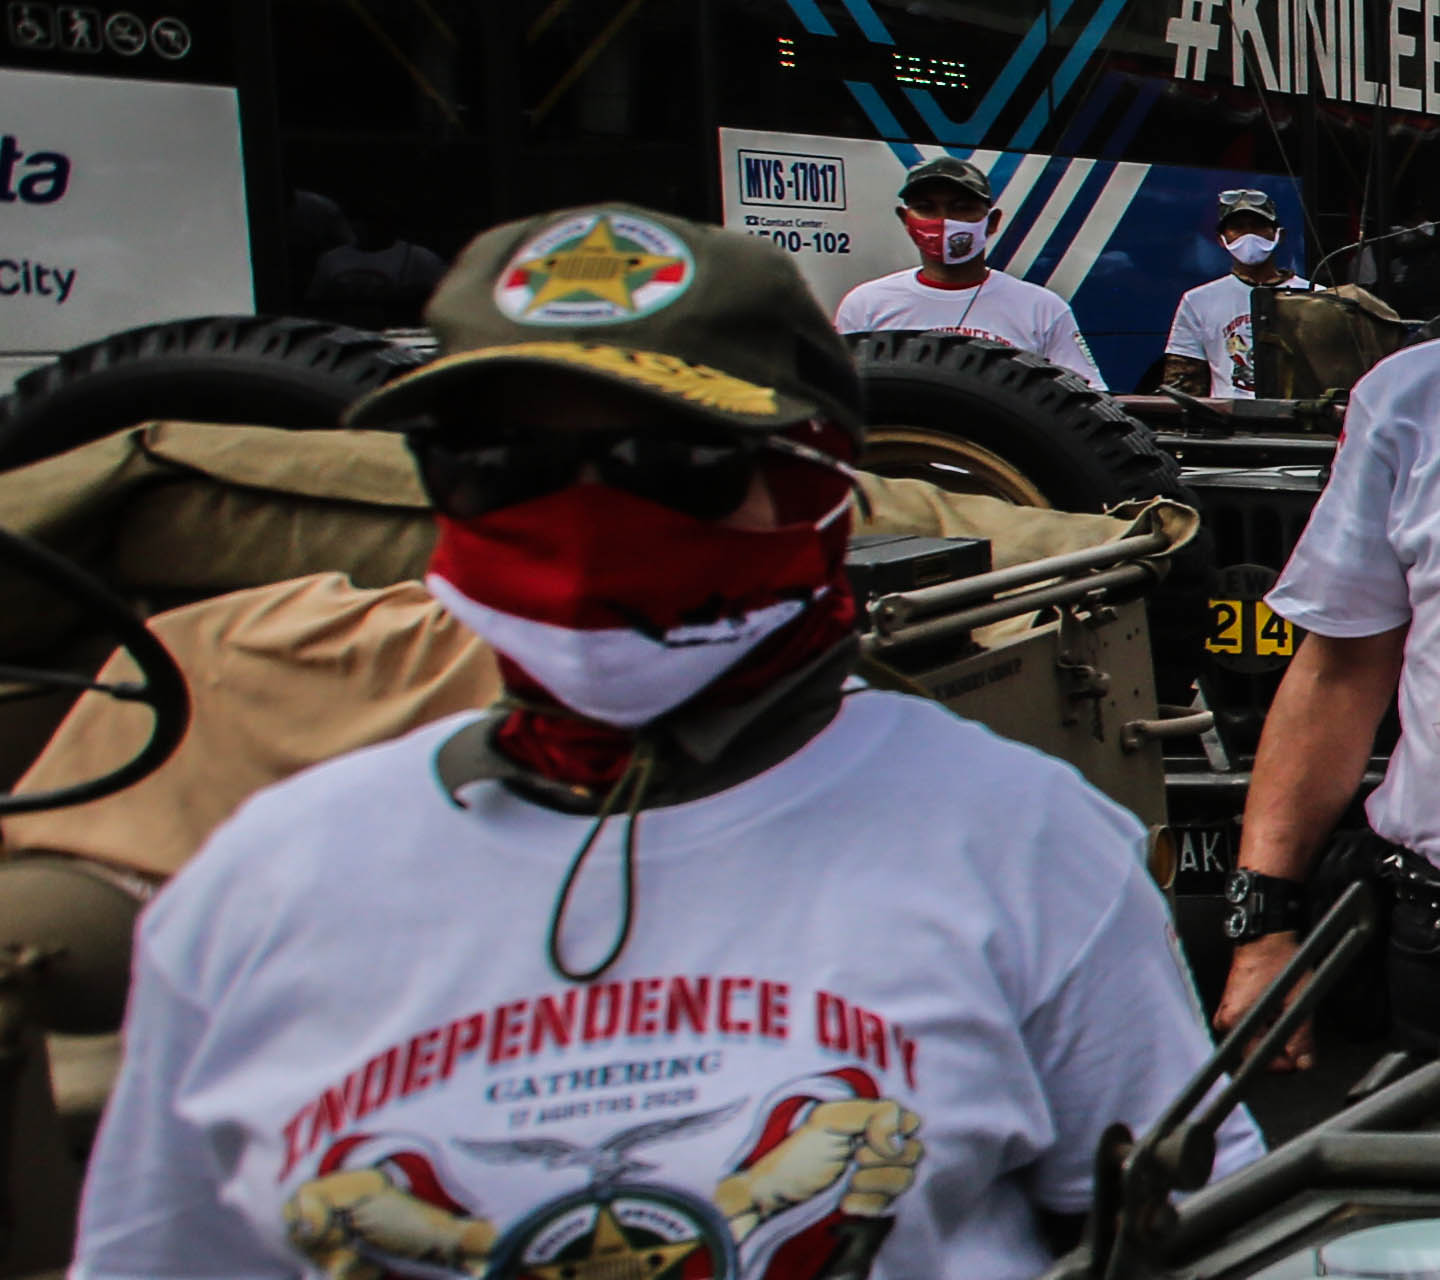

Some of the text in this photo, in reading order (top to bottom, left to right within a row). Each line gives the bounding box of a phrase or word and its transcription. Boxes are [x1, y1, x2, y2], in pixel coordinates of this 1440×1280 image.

[745, 157, 837, 203] MYS-17017
[750, 230, 850, 254] 00-102
[760, 216, 795, 228] Contact
[0, 258, 76, 304] City
[279, 974, 920, 1182] INDEPENDENCE DAY
[484, 1049, 723, 1105] GATHERING
